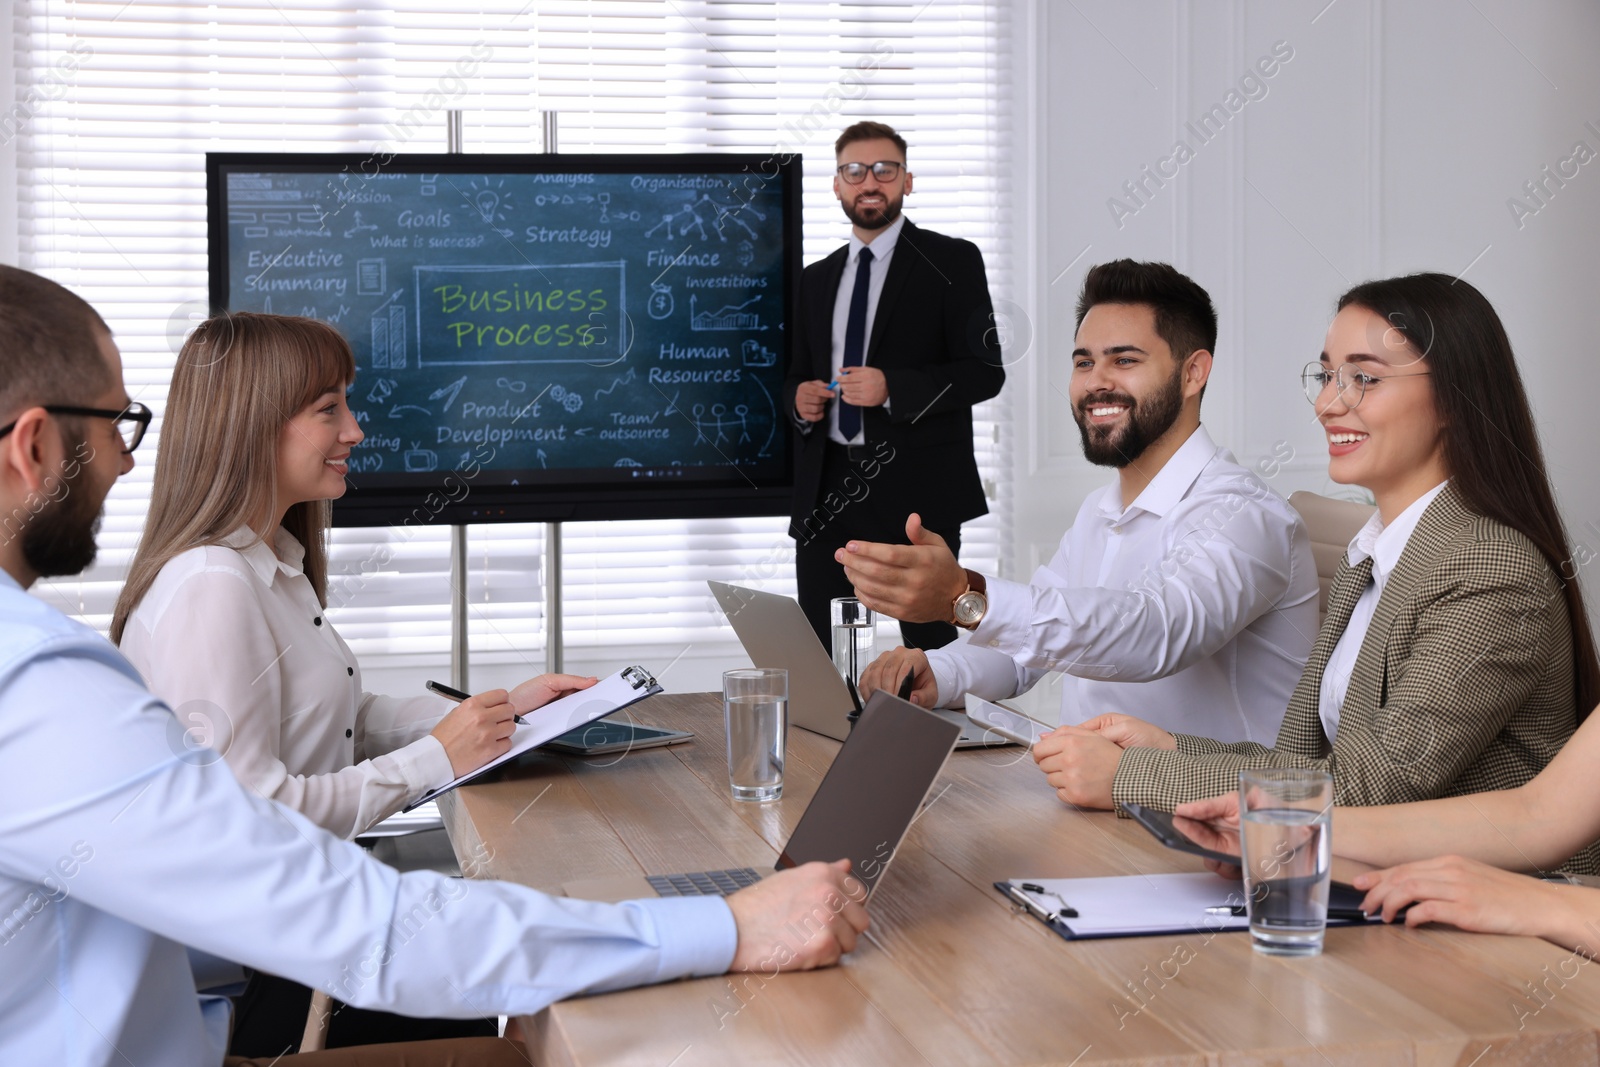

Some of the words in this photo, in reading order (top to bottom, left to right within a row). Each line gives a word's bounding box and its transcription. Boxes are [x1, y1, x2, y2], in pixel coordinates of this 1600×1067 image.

[630, 175, 724, 193] Organisation
[337, 189, 393, 204] Mission
[397, 208, 451, 230] Goals
[370, 235, 408, 249] What
[413, 235, 424, 249] is
[428, 235, 484, 249] success?
[525, 226, 612, 248] Strategy
[247, 249, 343, 268] Executive
[647, 249, 721, 268] Finance
[244, 273, 347, 297] Summary
[433, 283, 607, 313] Business
[447, 322, 595, 348] Process
[659, 343, 731, 361] Human
[649, 366, 741, 384] Resources
[462, 401, 542, 420] Product
[610, 411, 660, 427] Team/
[437, 425, 568, 449] Development
[600, 427, 670, 440] outsource
